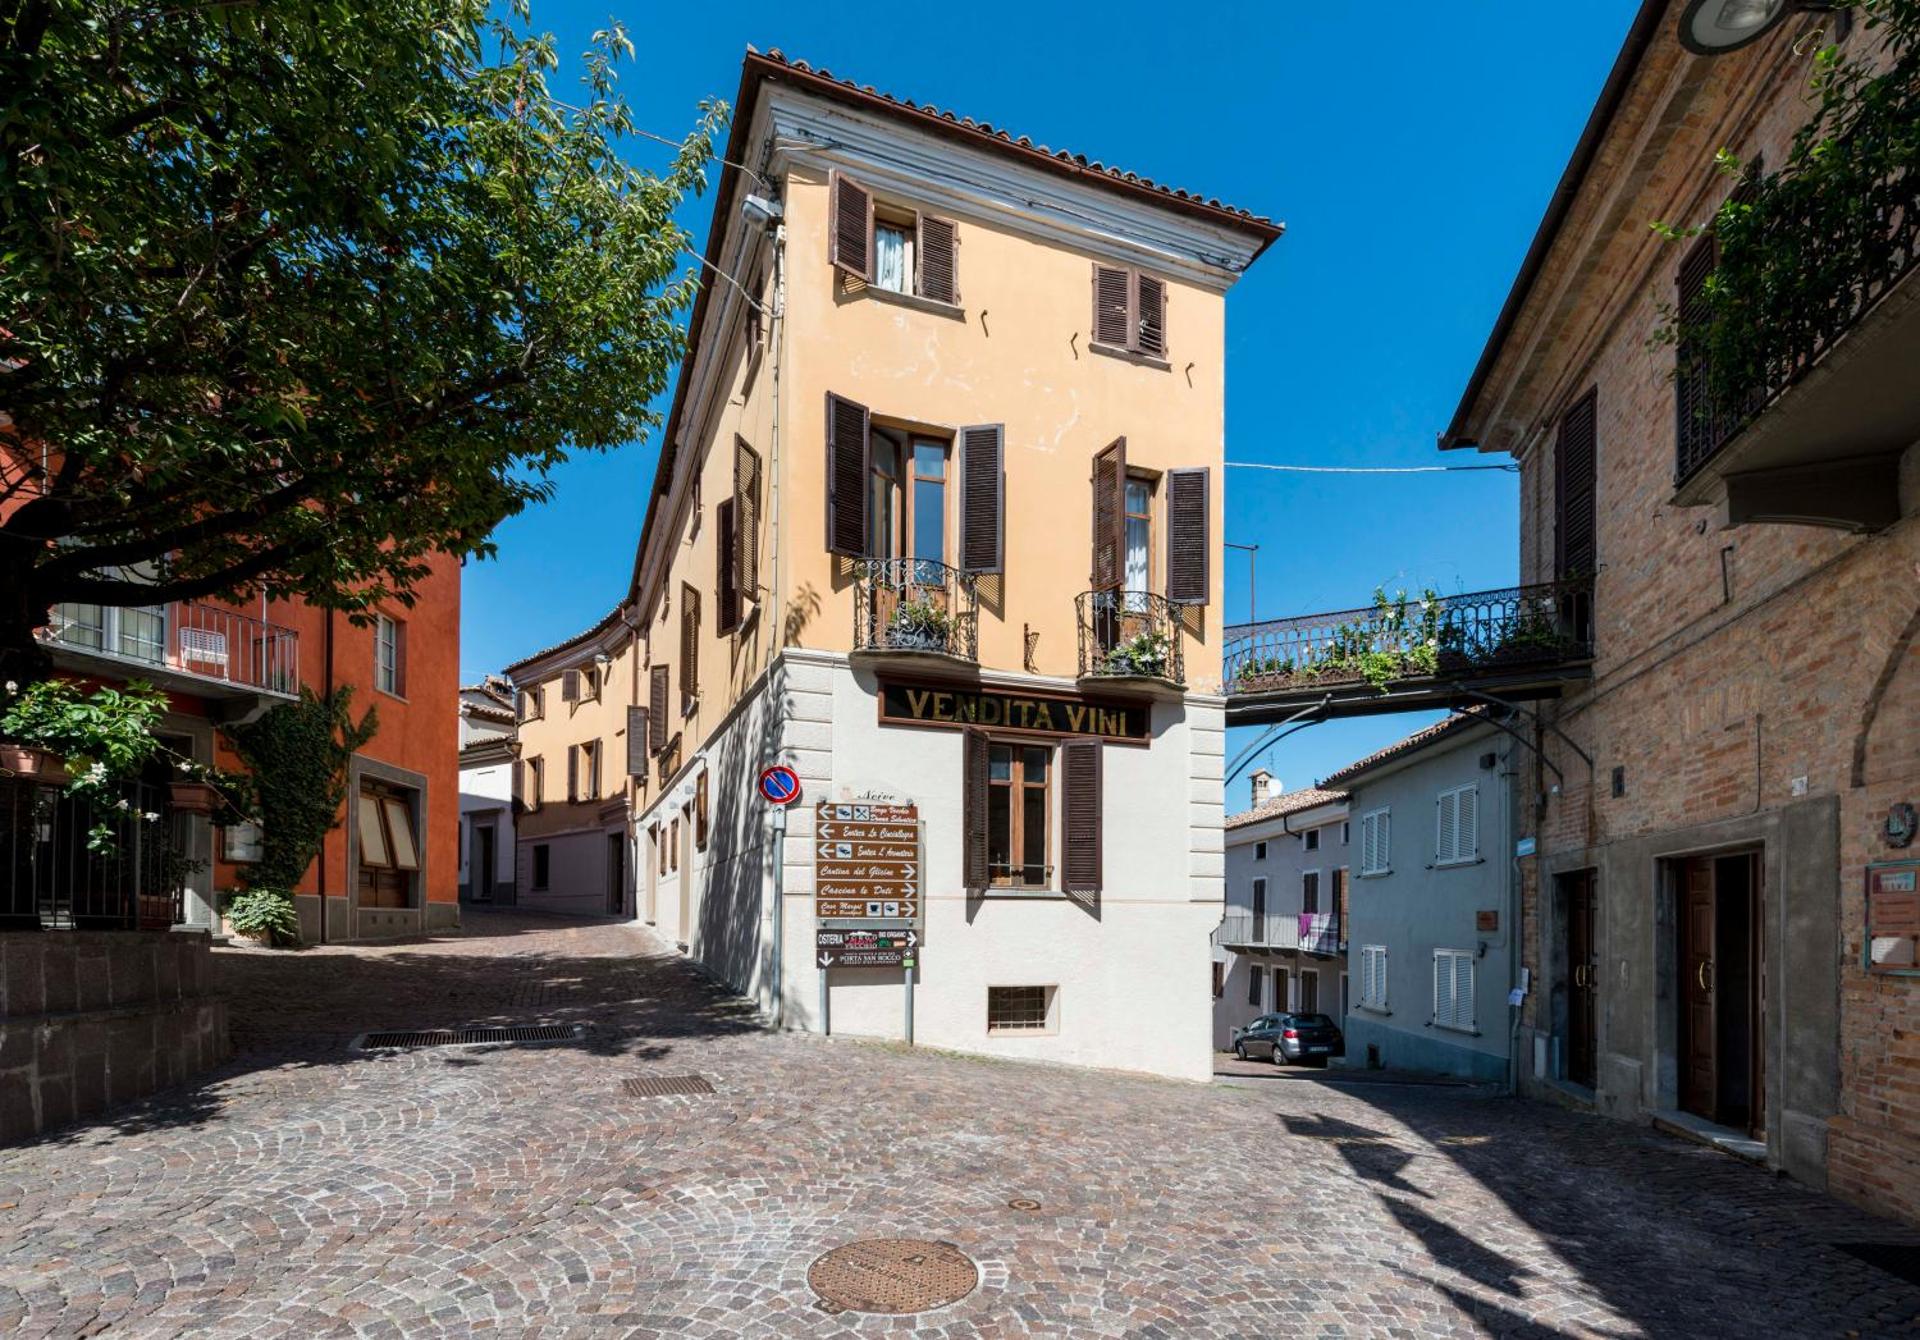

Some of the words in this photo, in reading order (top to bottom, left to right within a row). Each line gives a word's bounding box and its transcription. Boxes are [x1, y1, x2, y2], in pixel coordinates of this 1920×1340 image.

[906, 689, 1054, 730] VENDITA
[1065, 704, 1127, 737] VINI
[857, 790, 896, 801] Neive
[820, 865, 850, 876] Cantina
[853, 867, 865, 875] del
[820, 884, 857, 896] Cascina
[818, 933, 844, 945] OSTERIA
